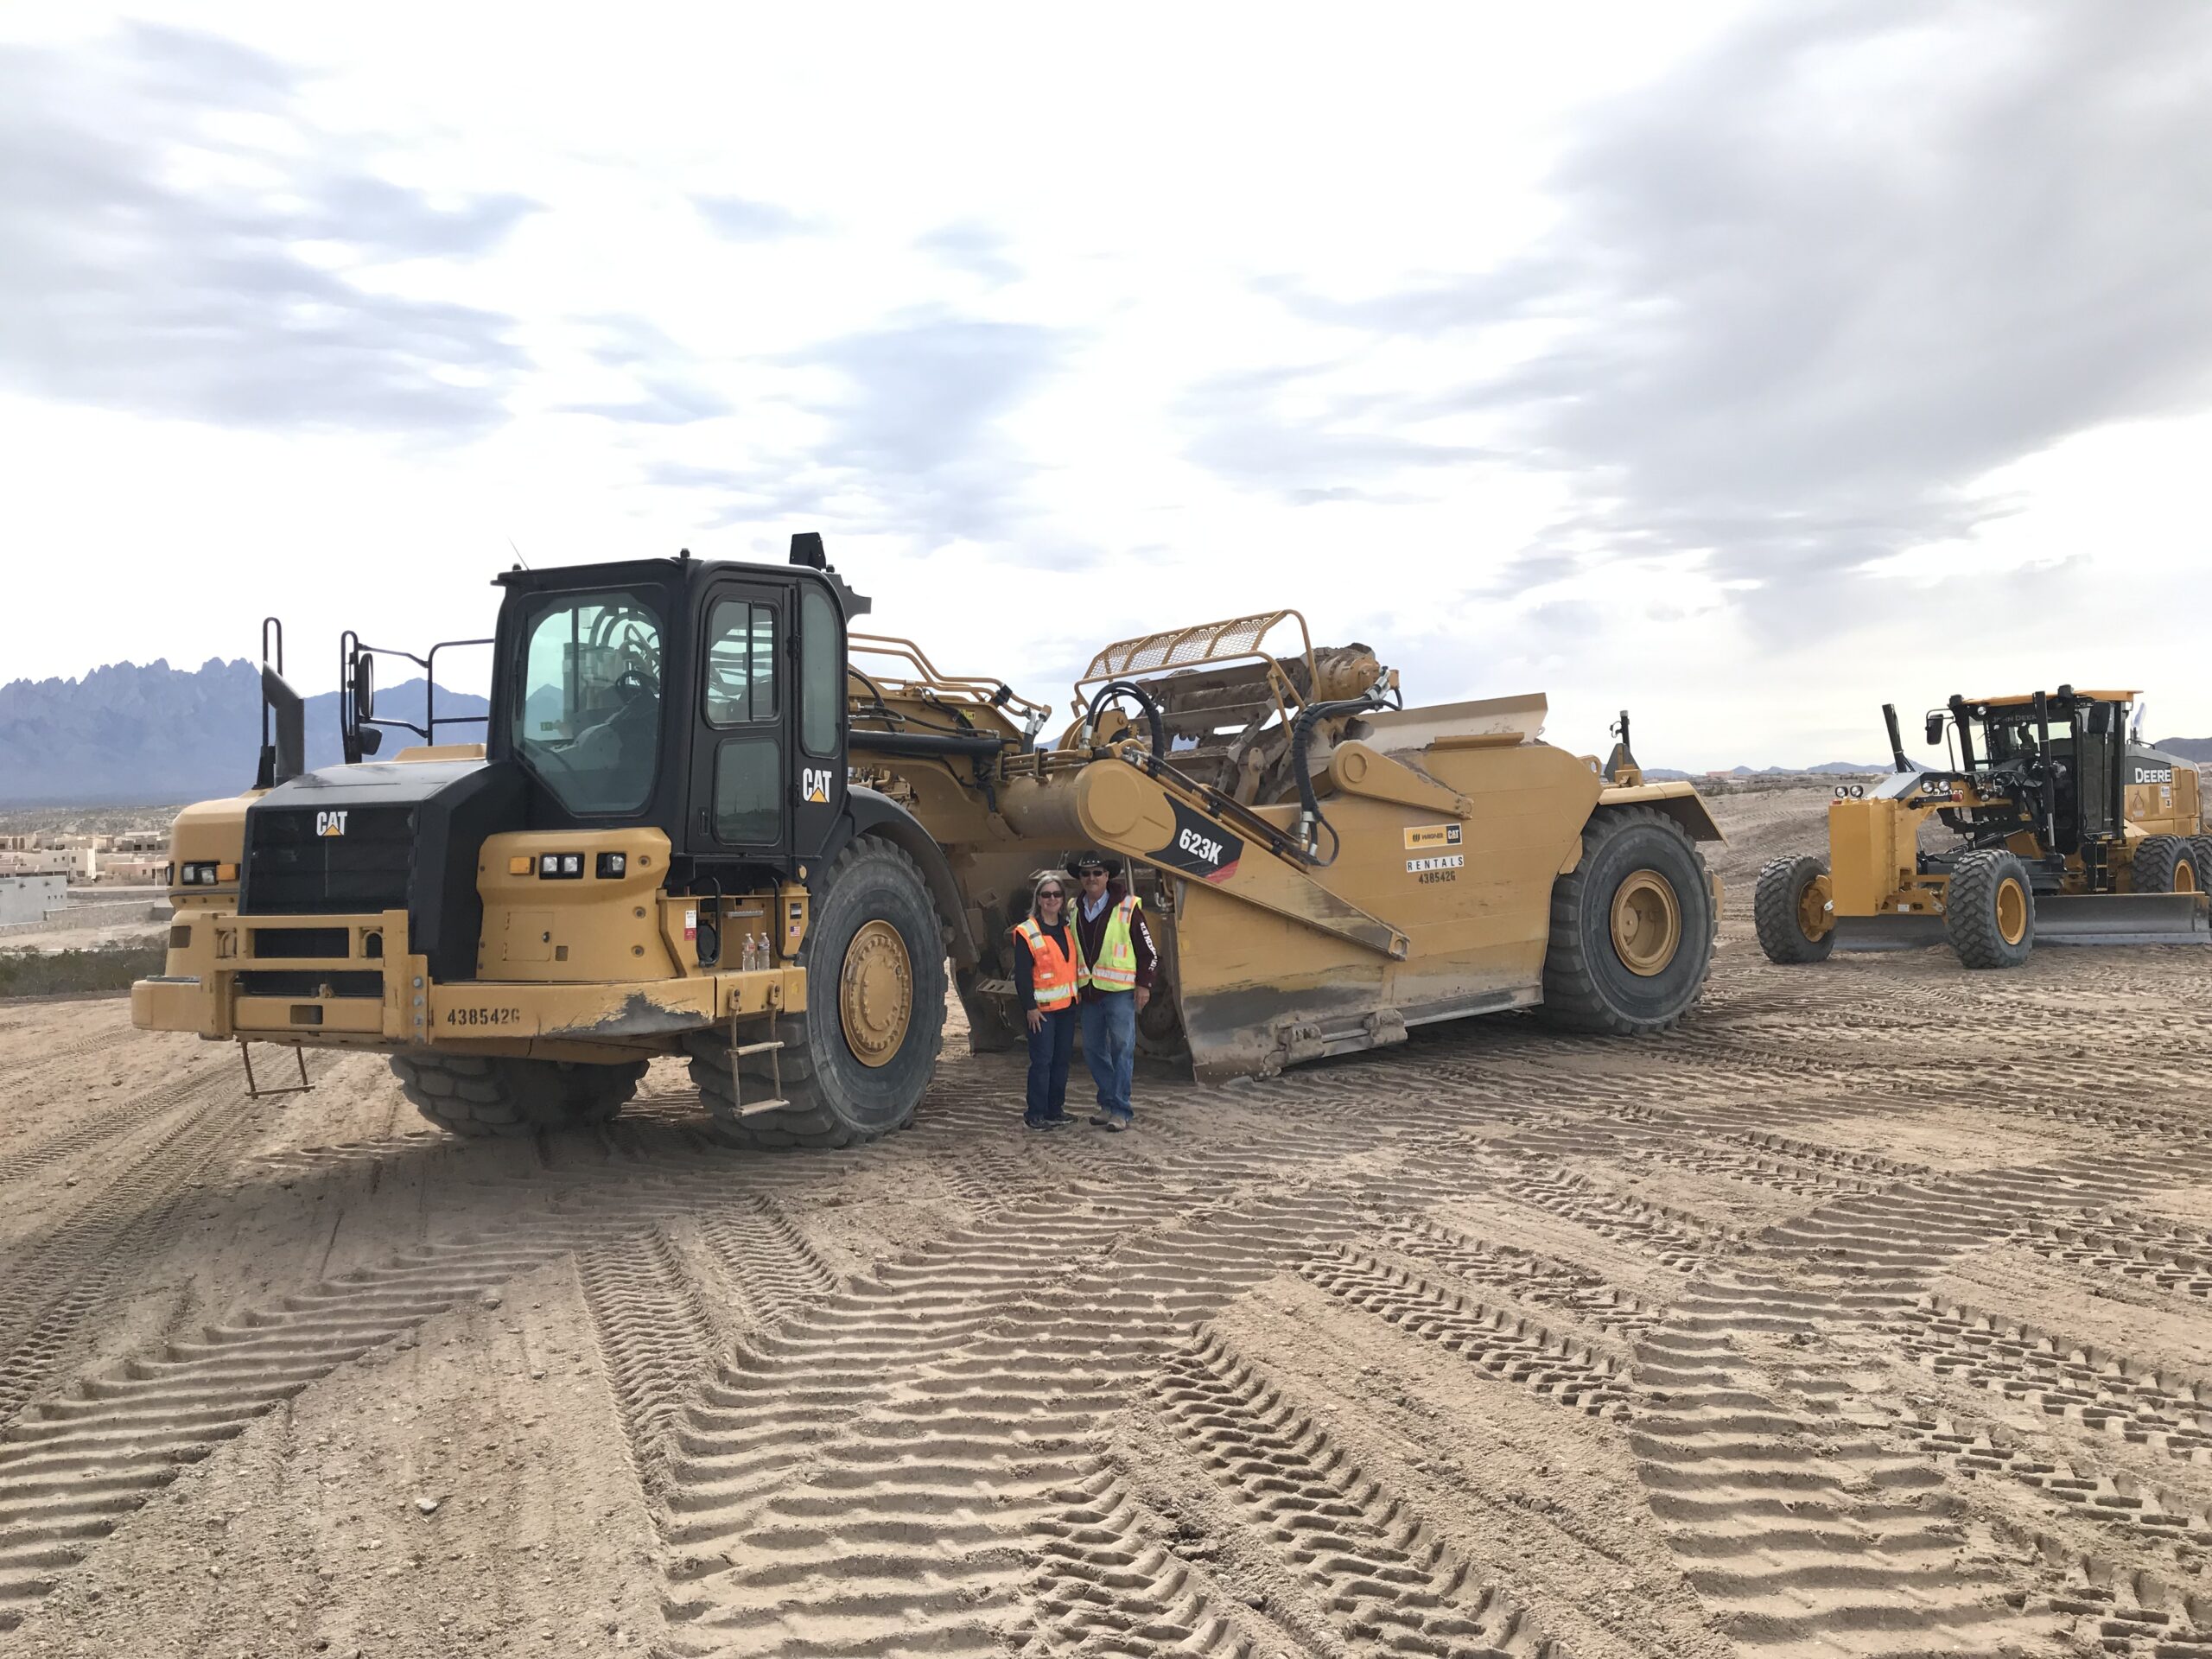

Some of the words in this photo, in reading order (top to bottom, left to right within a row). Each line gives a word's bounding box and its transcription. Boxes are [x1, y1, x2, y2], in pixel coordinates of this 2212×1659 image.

[2135, 767, 2171, 784] DEERE
[803, 767, 832, 804] CAT
[316, 810, 348, 836] CAT
[1447, 830, 1459, 840] CAT
[1179, 828, 1224, 865] 623K
[1408, 856, 1463, 871] RENTALS
[1418, 870, 1456, 884] 438542G
[447, 1007, 520, 1026] 438542G
